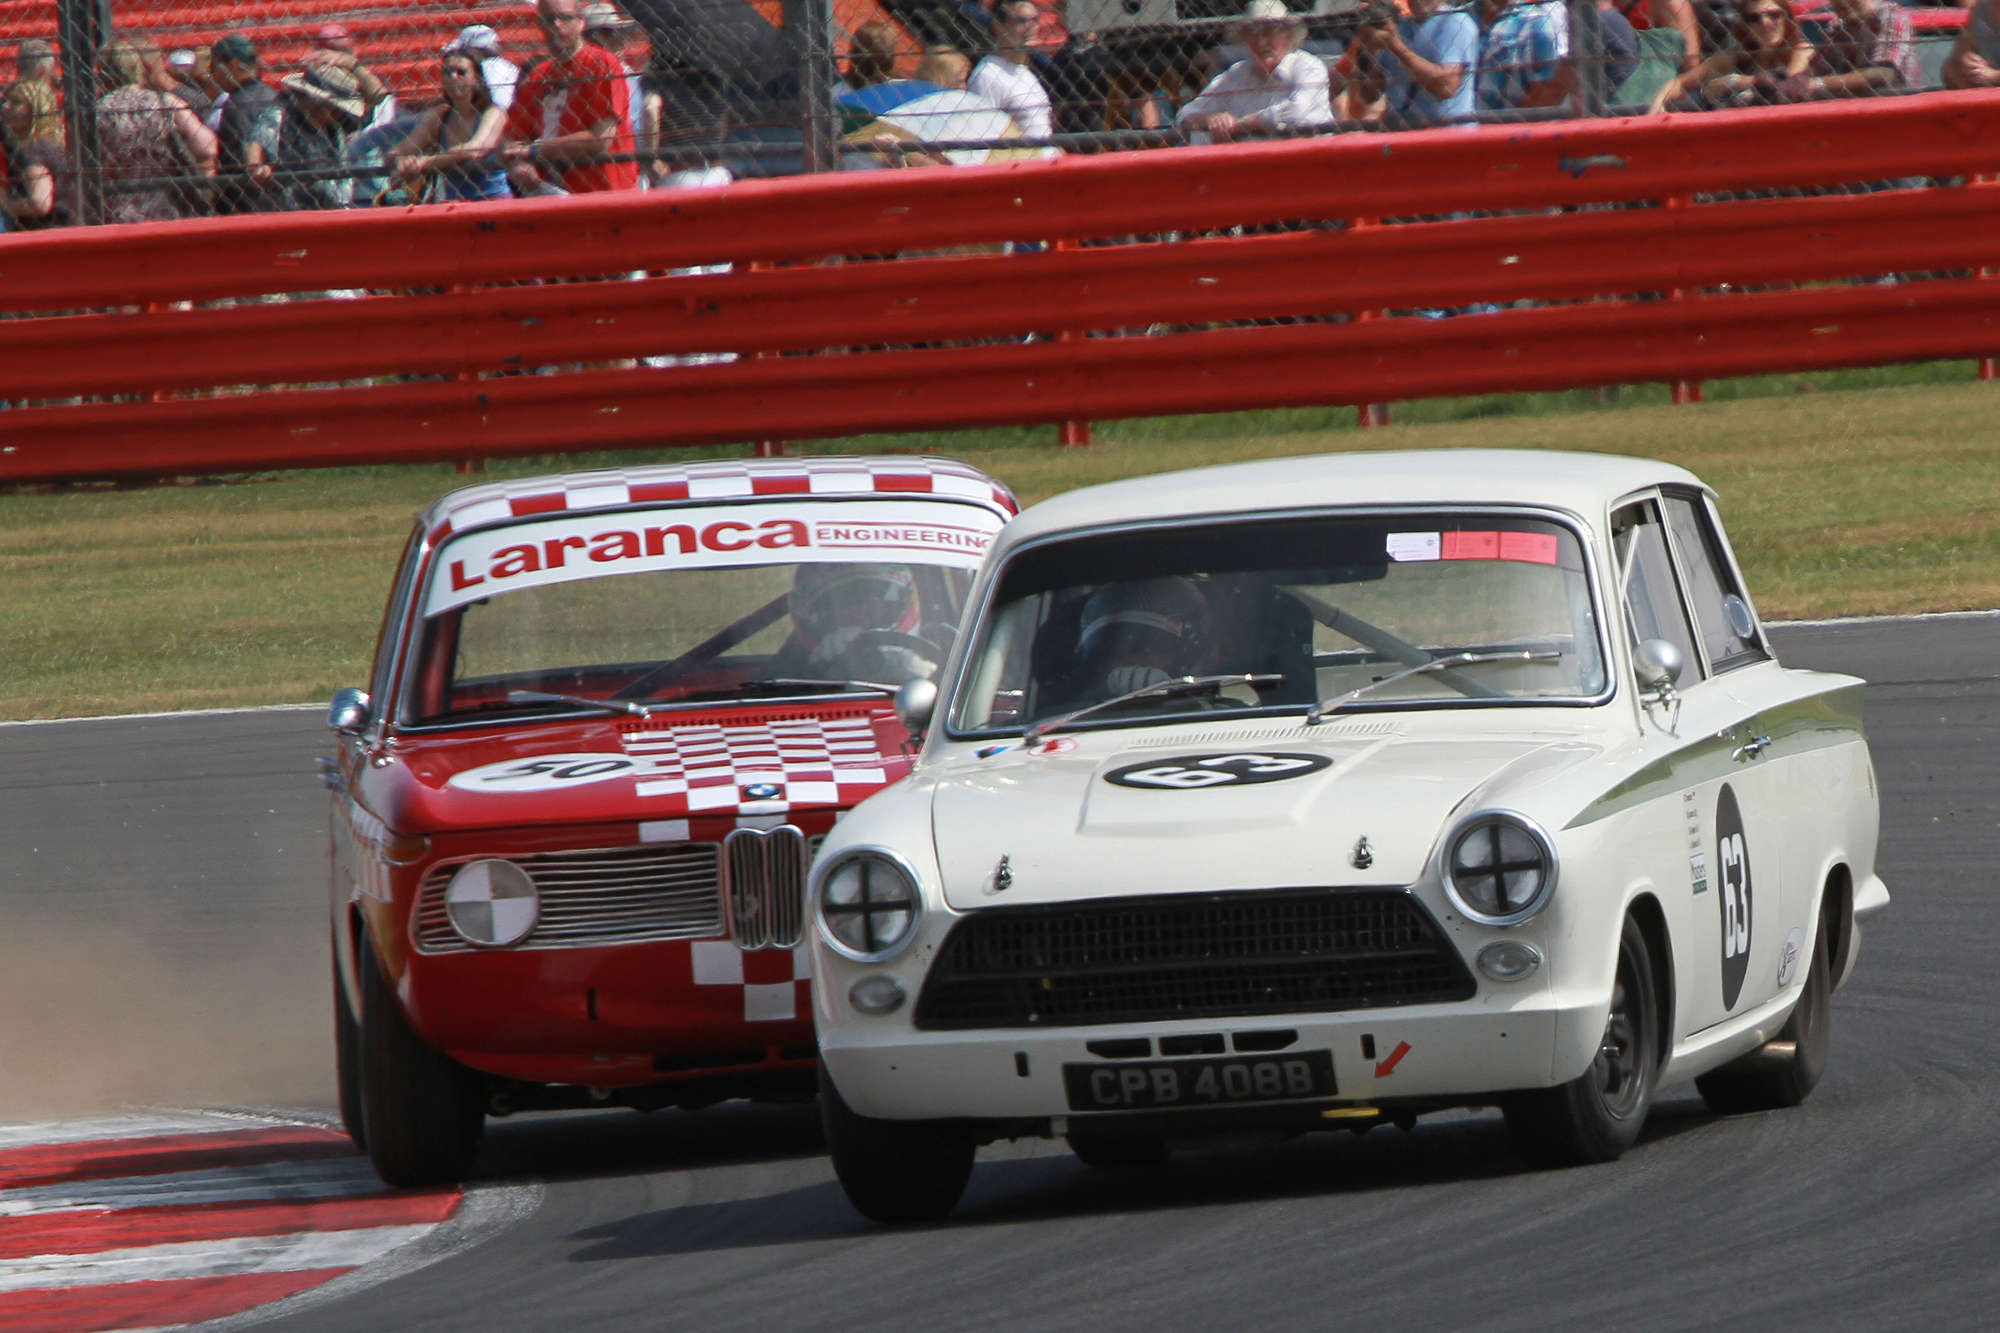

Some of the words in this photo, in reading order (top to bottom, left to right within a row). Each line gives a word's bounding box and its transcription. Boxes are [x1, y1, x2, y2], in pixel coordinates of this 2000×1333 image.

[451, 519, 810, 591] Laranca
[481, 760, 634, 781] 50
[1123, 754, 1314, 788] 63
[1720, 834, 1748, 958] 63
[1091, 1068, 1180, 1105] CPB
